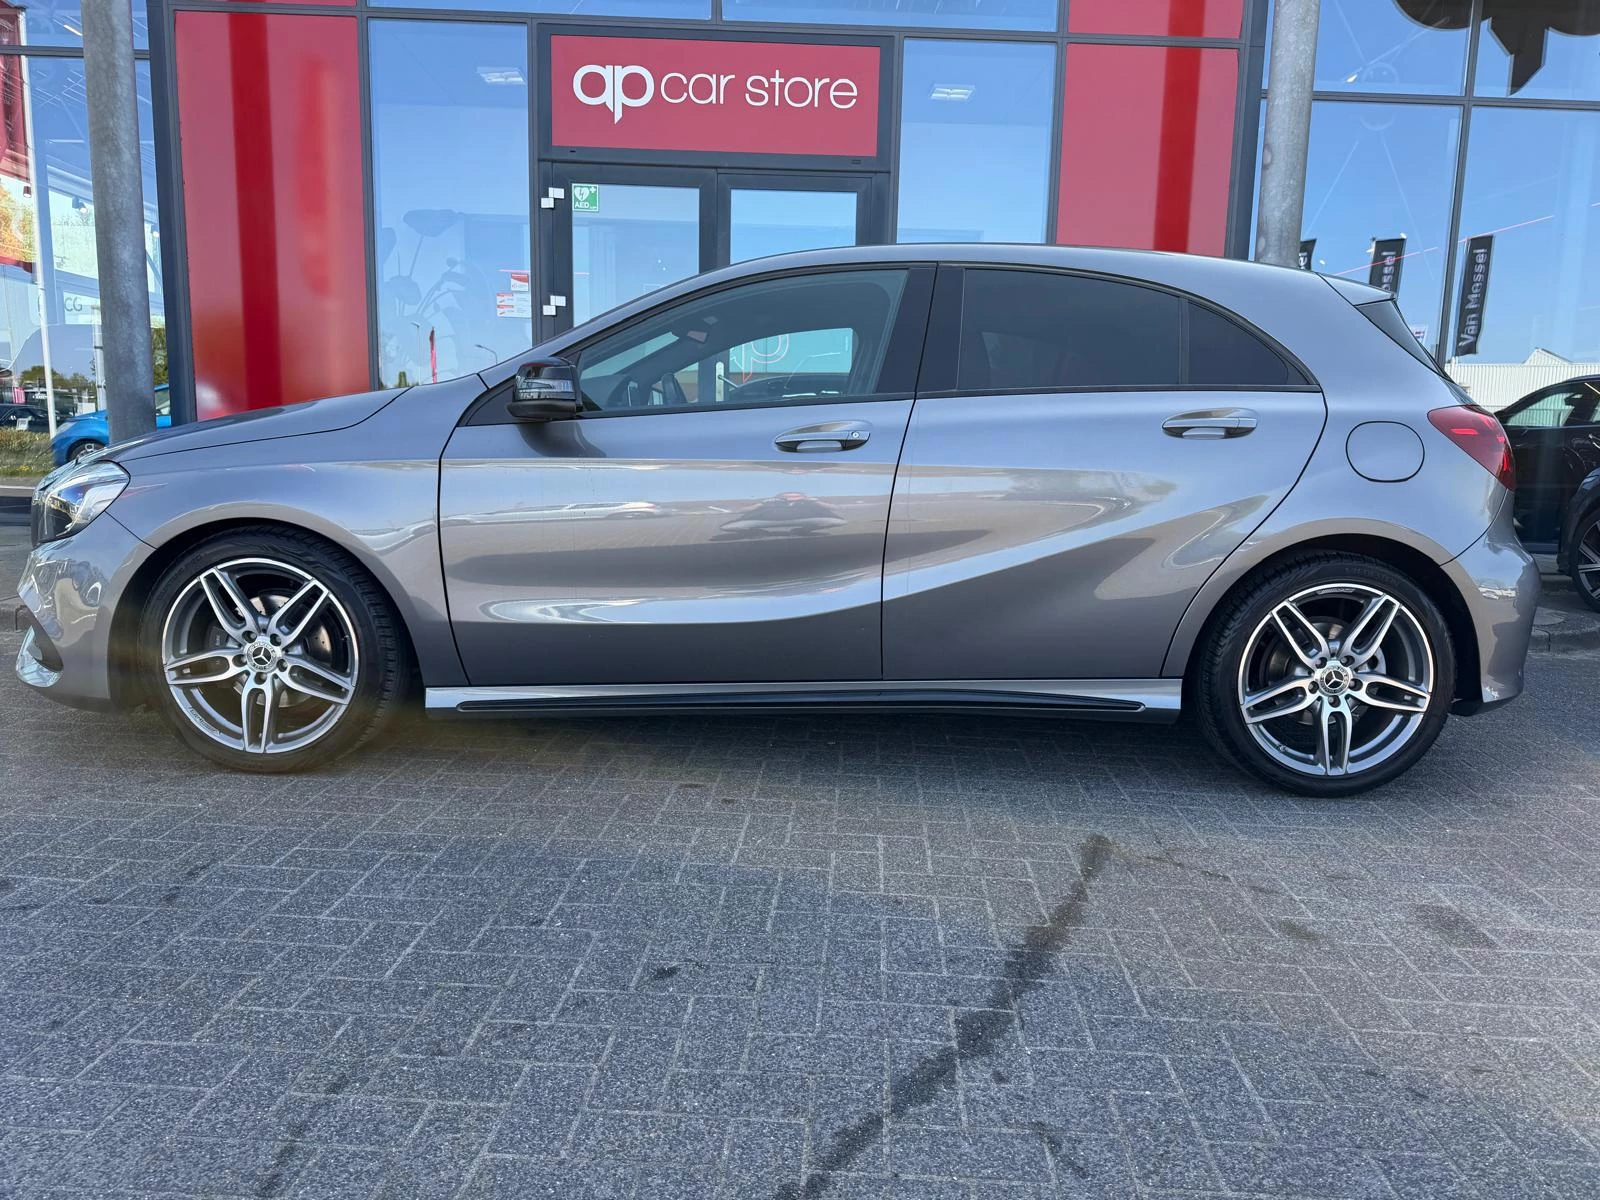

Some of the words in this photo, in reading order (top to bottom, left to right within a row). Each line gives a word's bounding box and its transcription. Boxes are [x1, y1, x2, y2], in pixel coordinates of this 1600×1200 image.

[660, 72, 735, 105] car
[745, 69, 858, 109] store
[575, 201, 590, 209] AED
[1381, 251, 1397, 291] ossel
[1465, 248, 1488, 310] Mossel
[1459, 313, 1480, 346] Van
